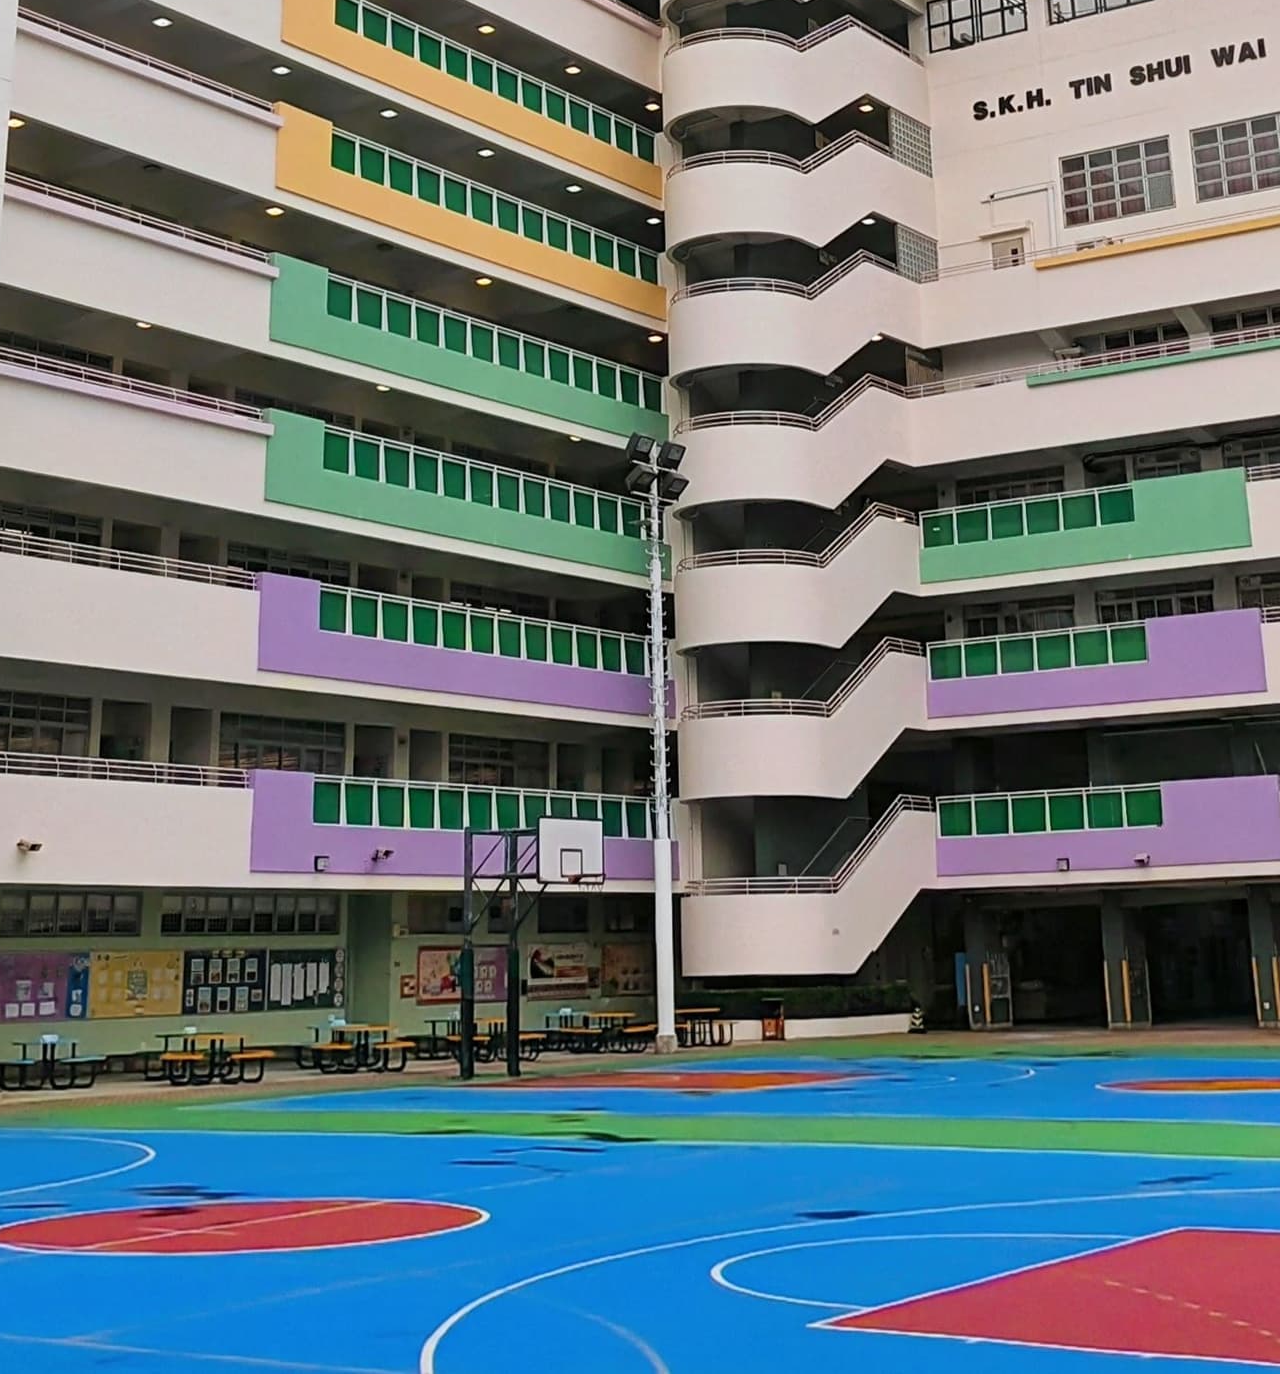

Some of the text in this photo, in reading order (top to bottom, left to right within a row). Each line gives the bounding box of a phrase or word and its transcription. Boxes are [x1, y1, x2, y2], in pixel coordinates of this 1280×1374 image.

[972, 88, 1052, 121] S.K.H.
[1068, 73, 1112, 100] TIN
[1129, 54, 1192, 86] SHUI
[1210, 38, 1267, 68] WAI
